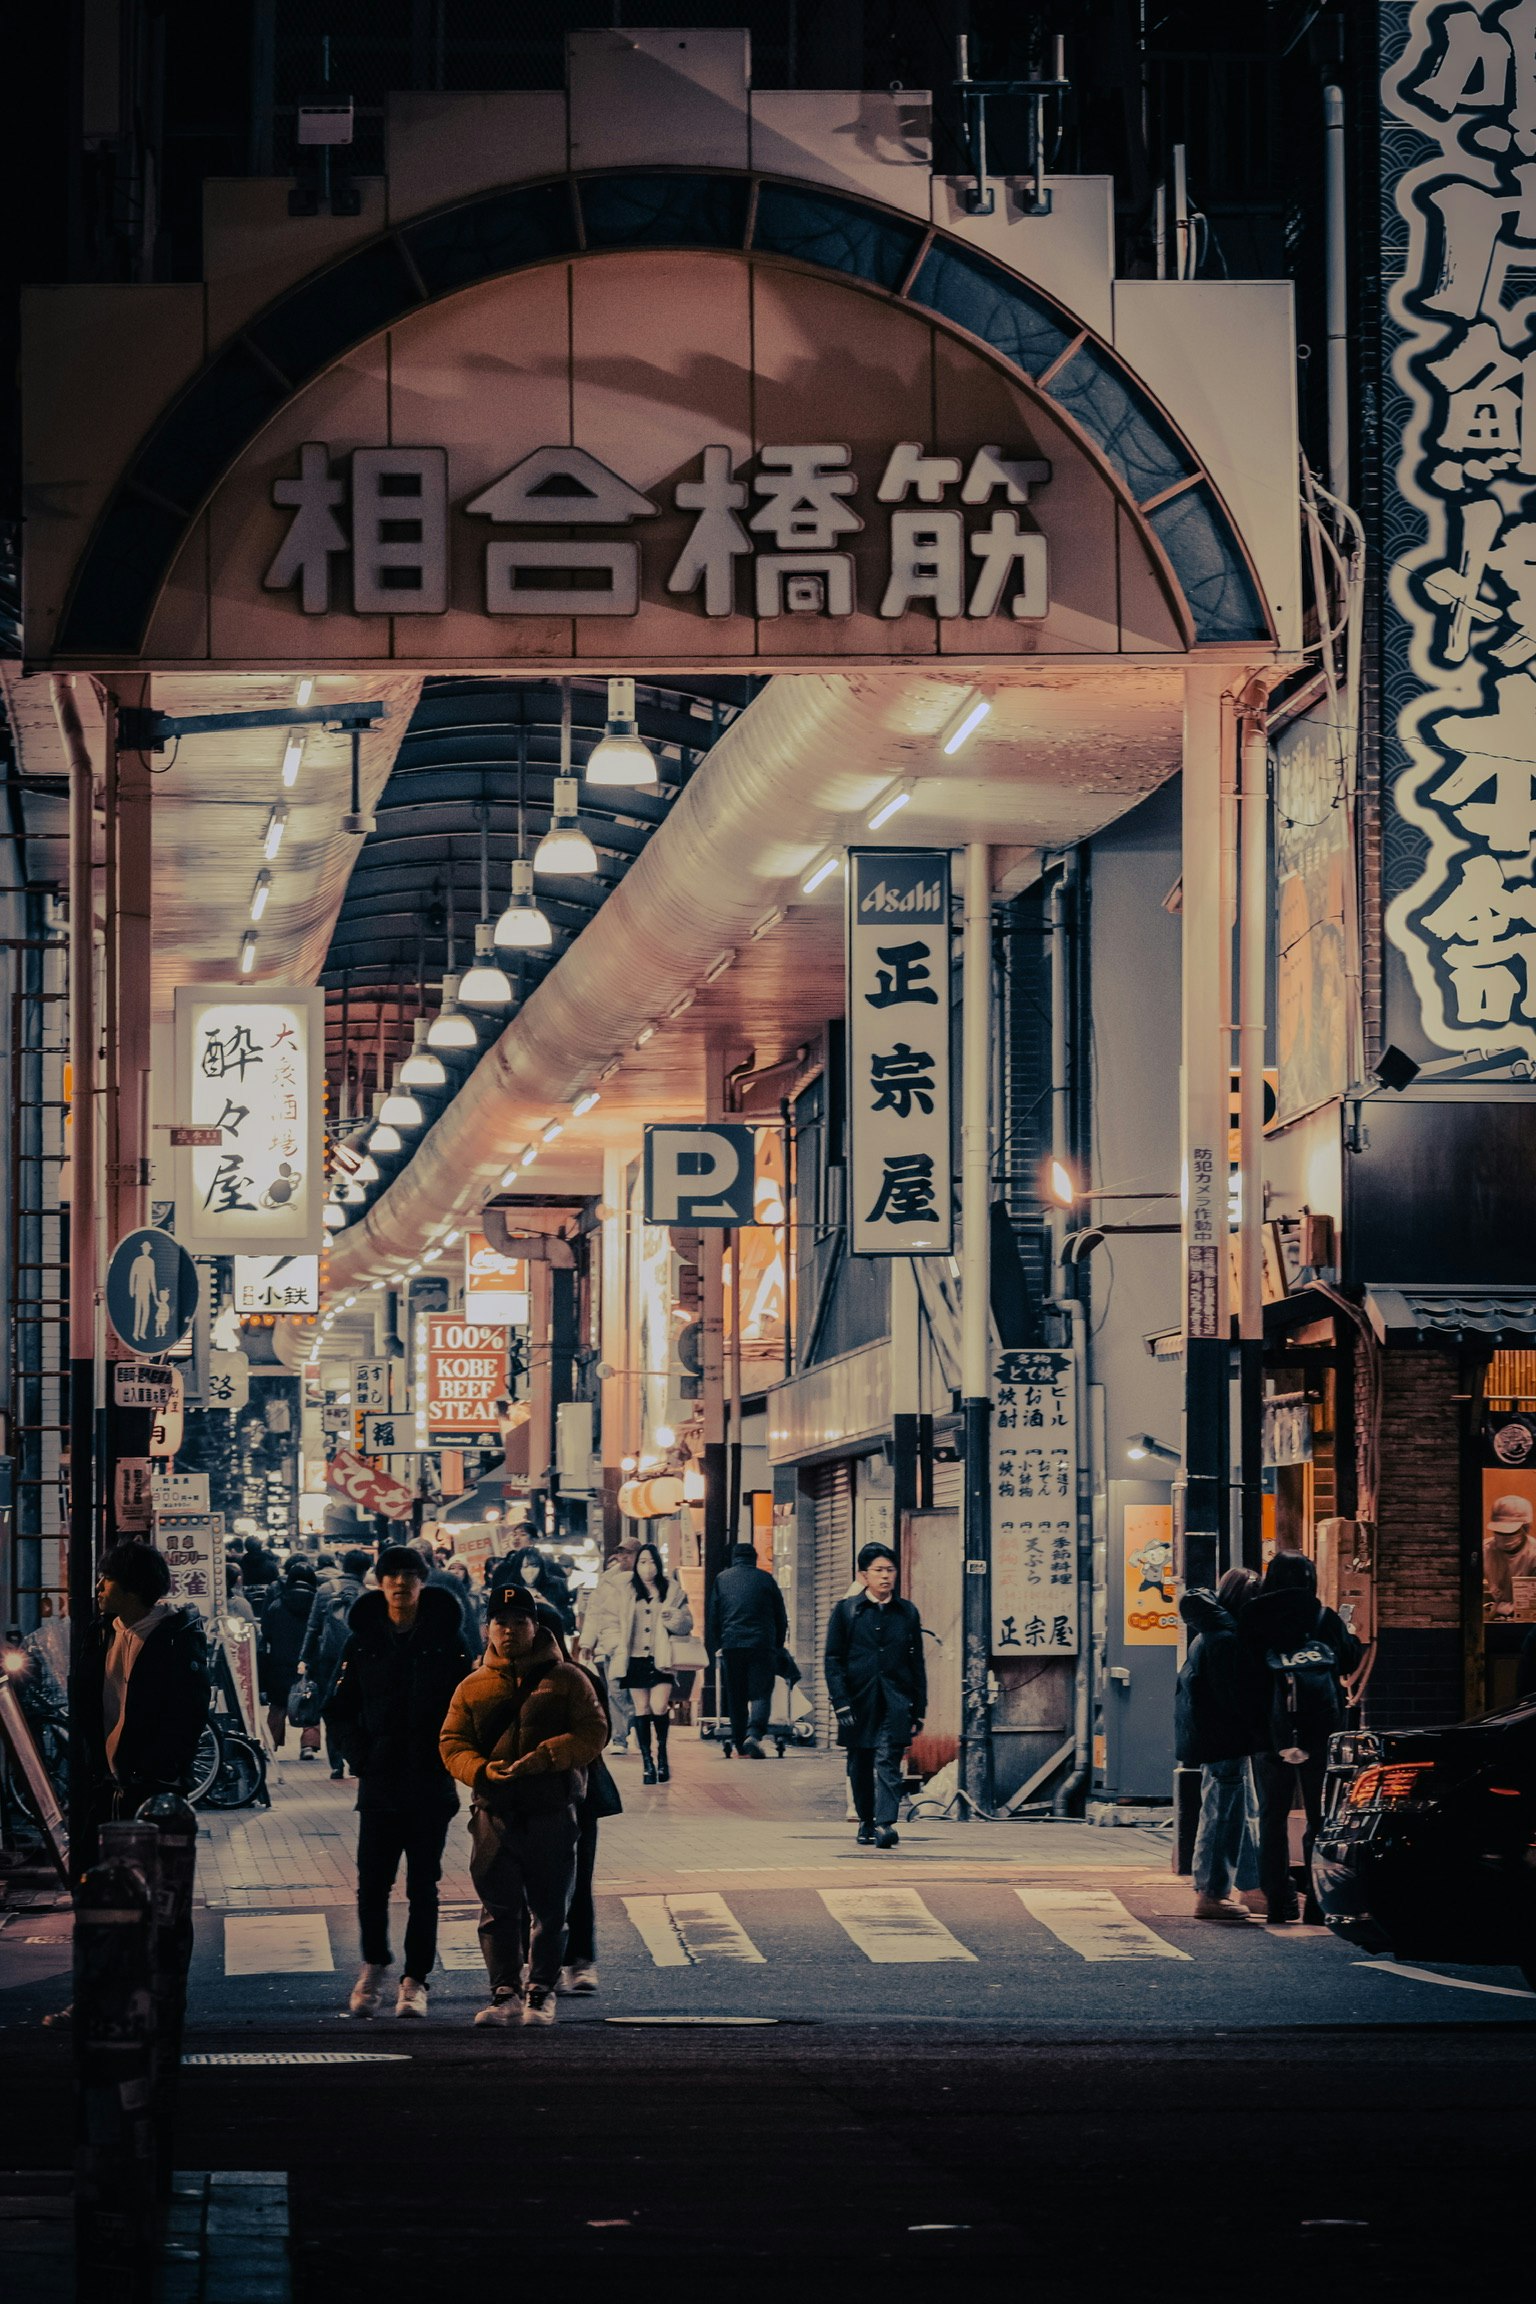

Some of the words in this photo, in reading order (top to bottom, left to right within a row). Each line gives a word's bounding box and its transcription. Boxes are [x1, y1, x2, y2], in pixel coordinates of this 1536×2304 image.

[264, 442, 1052, 619] 相合橋筋
[860, 880, 941, 914] Asahi
[865, 940, 940, 1225] 正宗屋
[202, 1025, 264, 1213] 酔々屋
[653, 1131, 740, 1220] P
[1194, 1149, 1212, 1243] 防犯カメラ作動中
[258, 1286, 309, 1306] 小鉄
[431, 1326, 504, 1349] 100%
[436, 1358, 498, 1378] KOBE
[1010, 1366, 1055, 1381] どて焼
[1017, 1354, 1052, 1364] 名物
[438, 1380, 496, 1399] BEEF
[1051, 1386, 1069, 1426] ビール
[998, 1386, 1017, 1428] 焼酎
[1023, 1386, 1044, 1428] お酒
[1039, 1459, 1053, 1496] おでん
[458, 1537, 492, 1553] BEER
[1050, 1536, 1073, 1585] 季節料理
[504, 1589, 515, 1604] P
[998, 1615, 1073, 1648] 正宗屋
[1280, 1651, 1323, 1666] Lee
